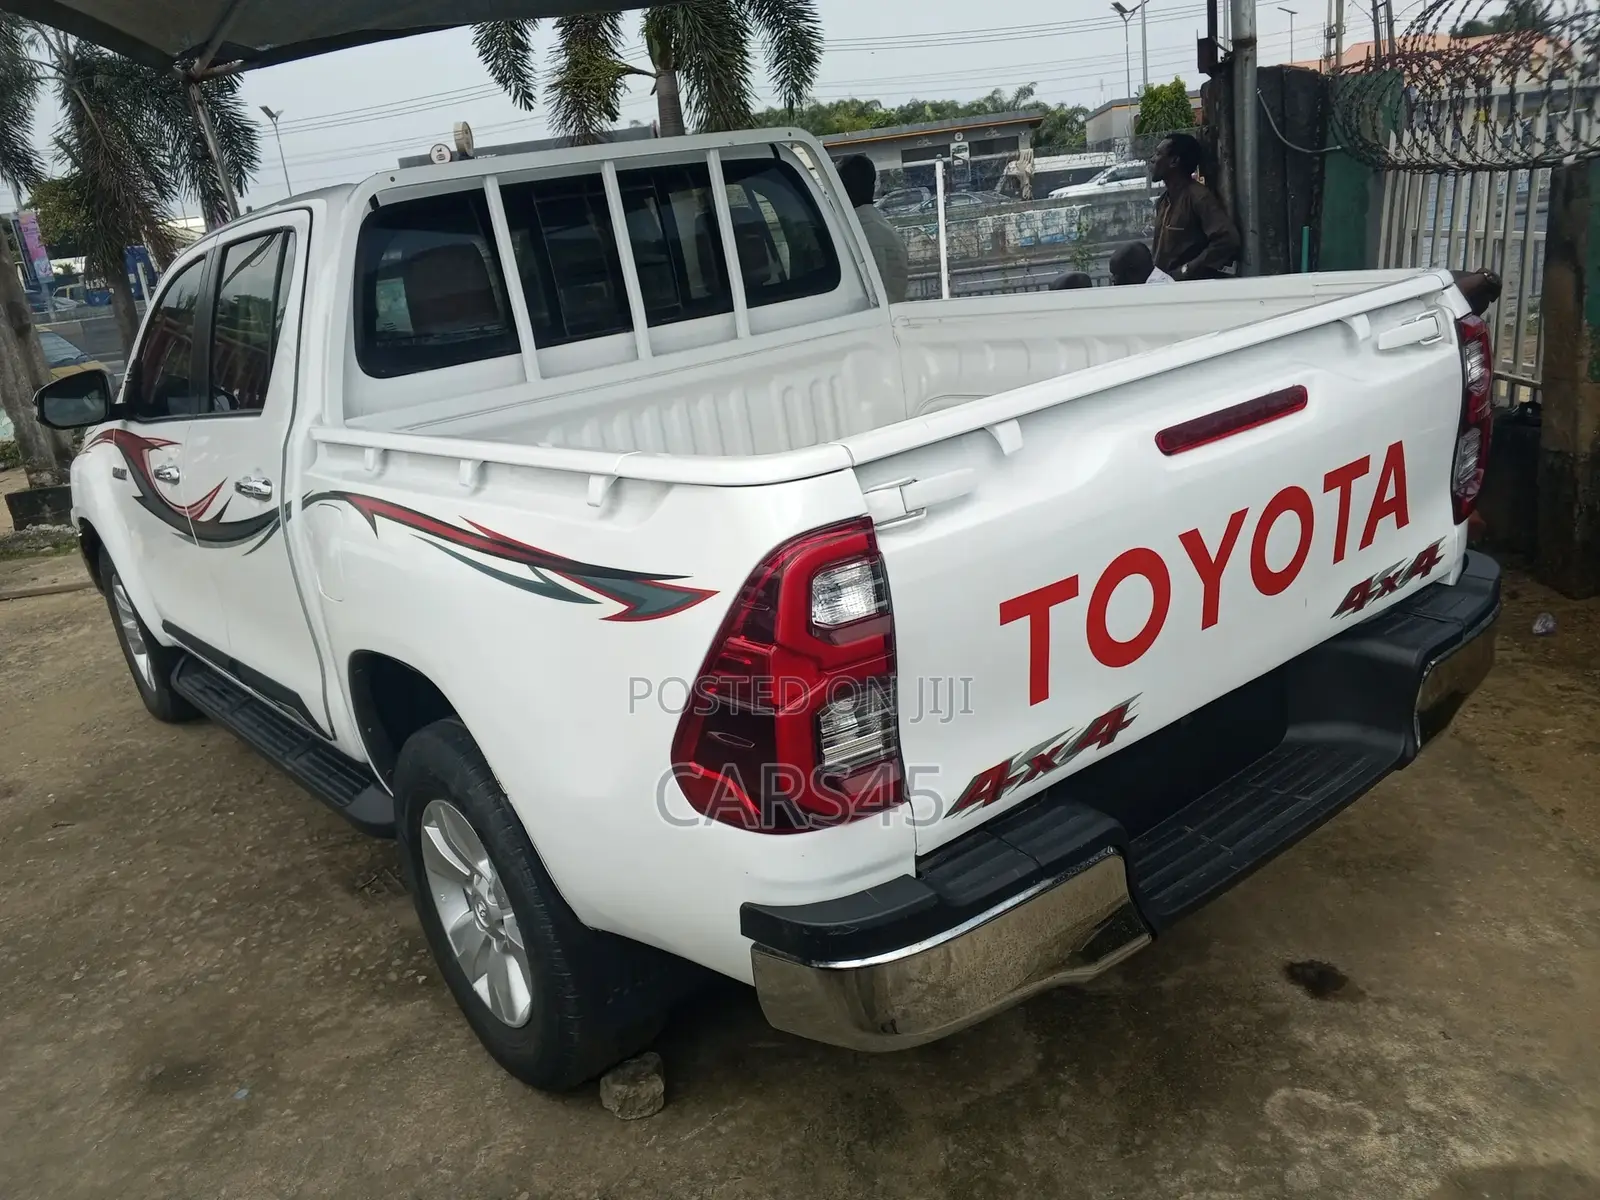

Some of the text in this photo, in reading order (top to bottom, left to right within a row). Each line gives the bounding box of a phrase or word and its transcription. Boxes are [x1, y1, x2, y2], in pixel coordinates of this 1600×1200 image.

[1000, 440, 1409, 706] TOYOTA
[1330, 536, 1446, 619] 4x4
[943, 693, 1142, 819] 4x4
